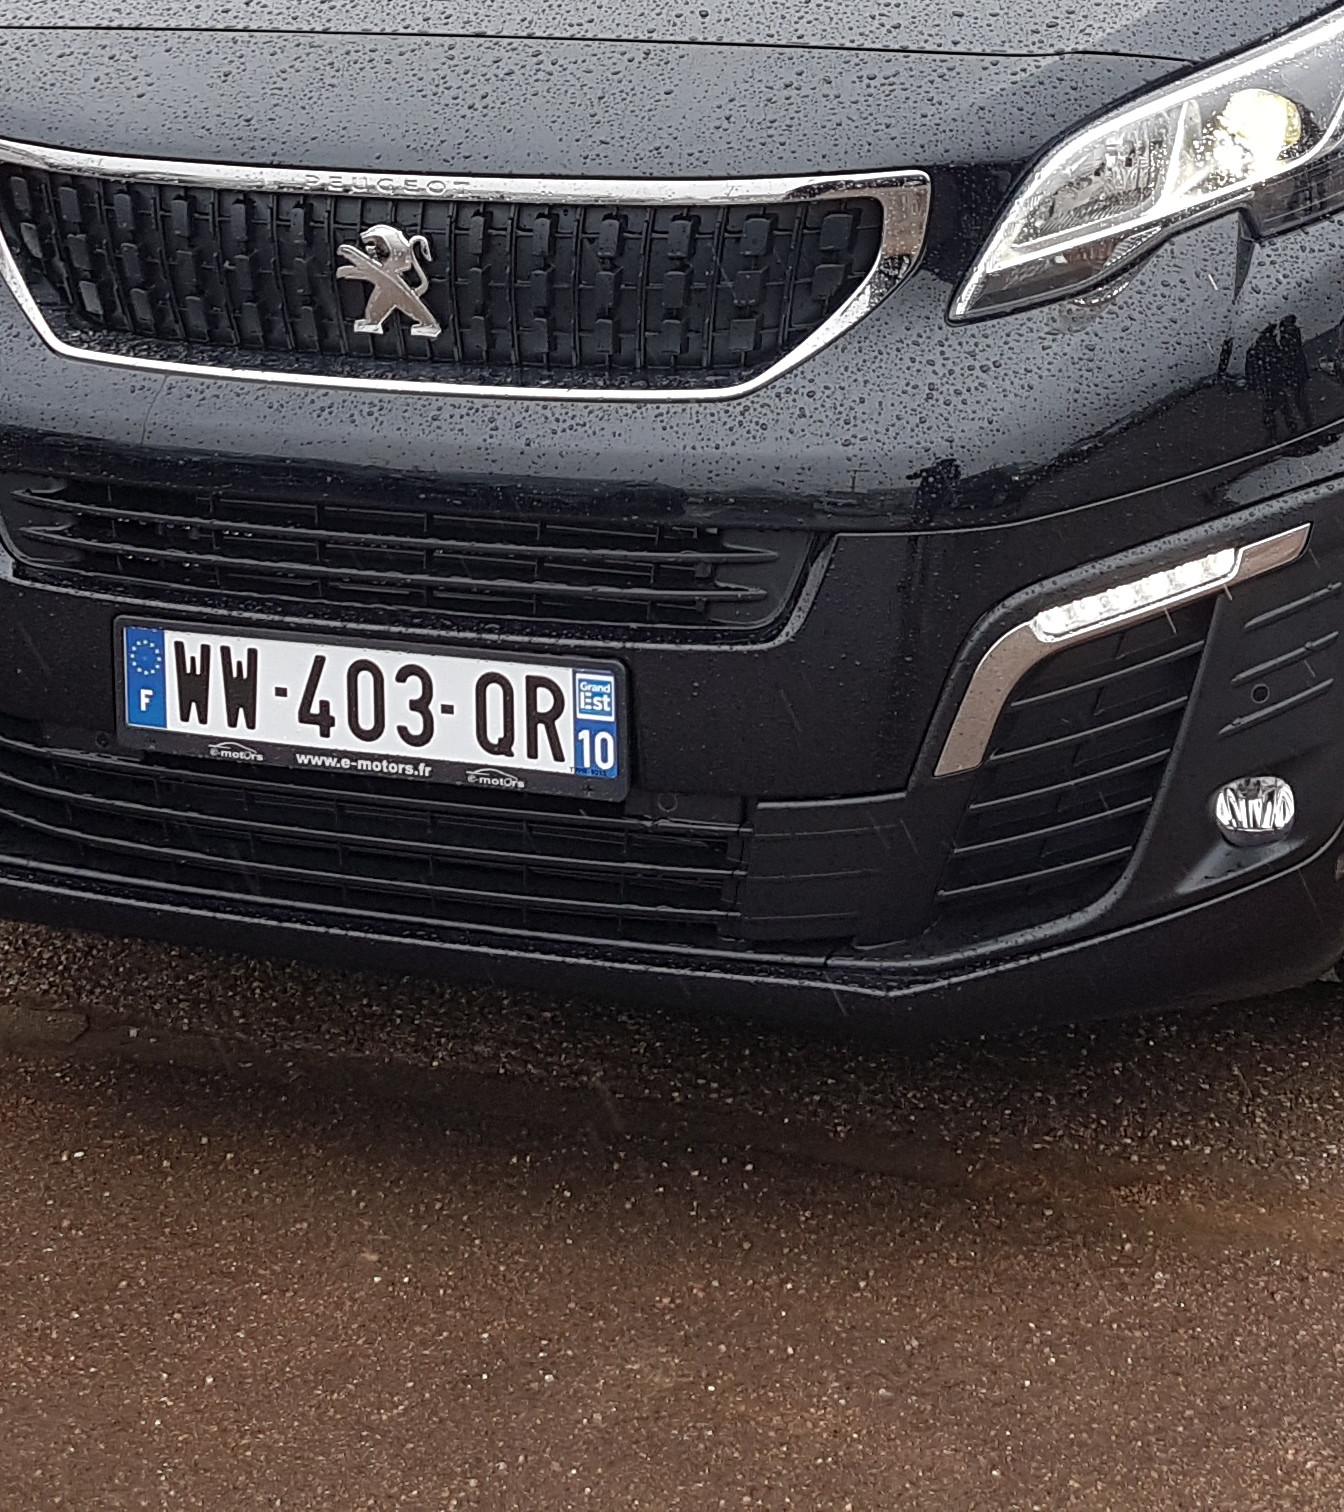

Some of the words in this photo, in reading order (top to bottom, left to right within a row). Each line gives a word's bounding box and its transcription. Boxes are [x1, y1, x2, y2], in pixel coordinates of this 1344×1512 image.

[305, 174, 470, 196] PEUGEOT
[579, 681, 611, 693] Grand
[140, 688, 154, 712] F
[579, 694, 611, 712] Est
[577, 729, 614, 770] 10
[295, 752, 432, 778] www.e-motors.fr
